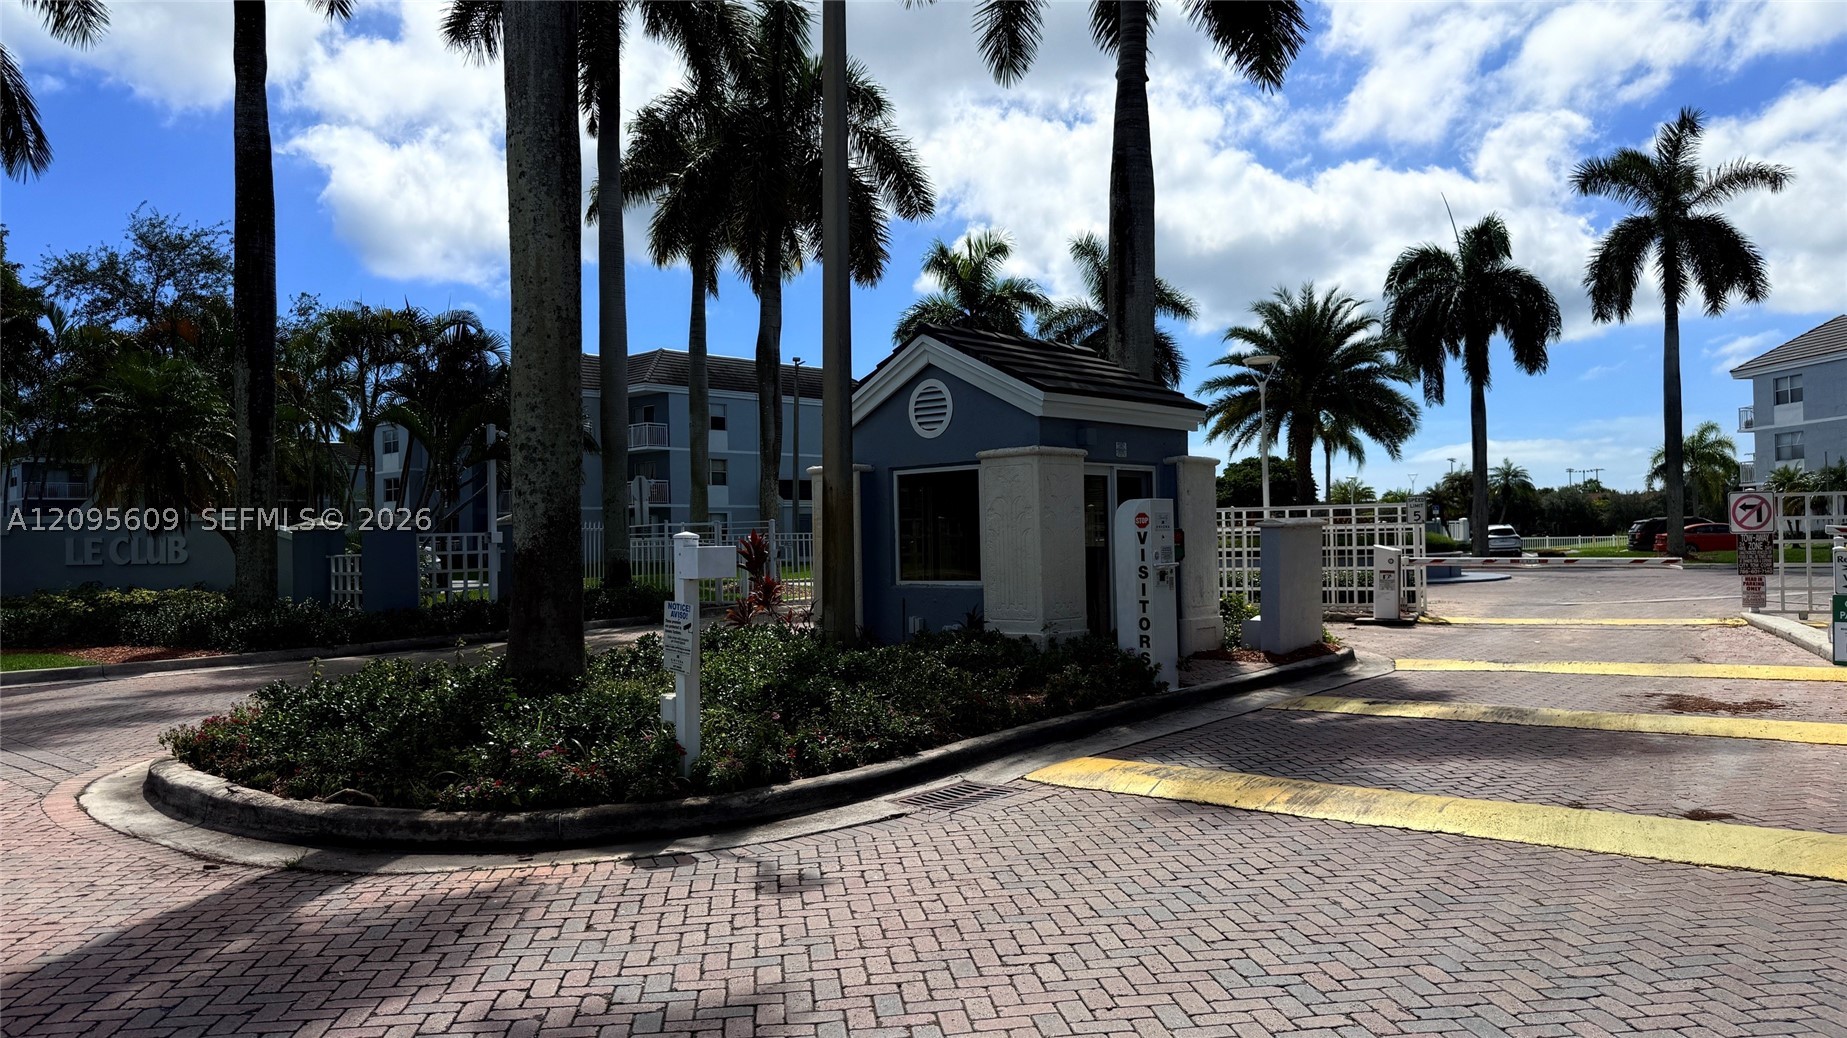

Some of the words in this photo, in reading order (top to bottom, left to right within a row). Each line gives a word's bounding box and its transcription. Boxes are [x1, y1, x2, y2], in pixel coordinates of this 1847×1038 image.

[1413, 511, 1421, 521] 5
[1748, 542, 1764, 550] ZONE
[64, 537, 104, 566] LE
[109, 537, 189, 566] CLUB
[1136, 531, 1151, 666] VISITORS
[668, 602, 691, 612] NOTICE!
